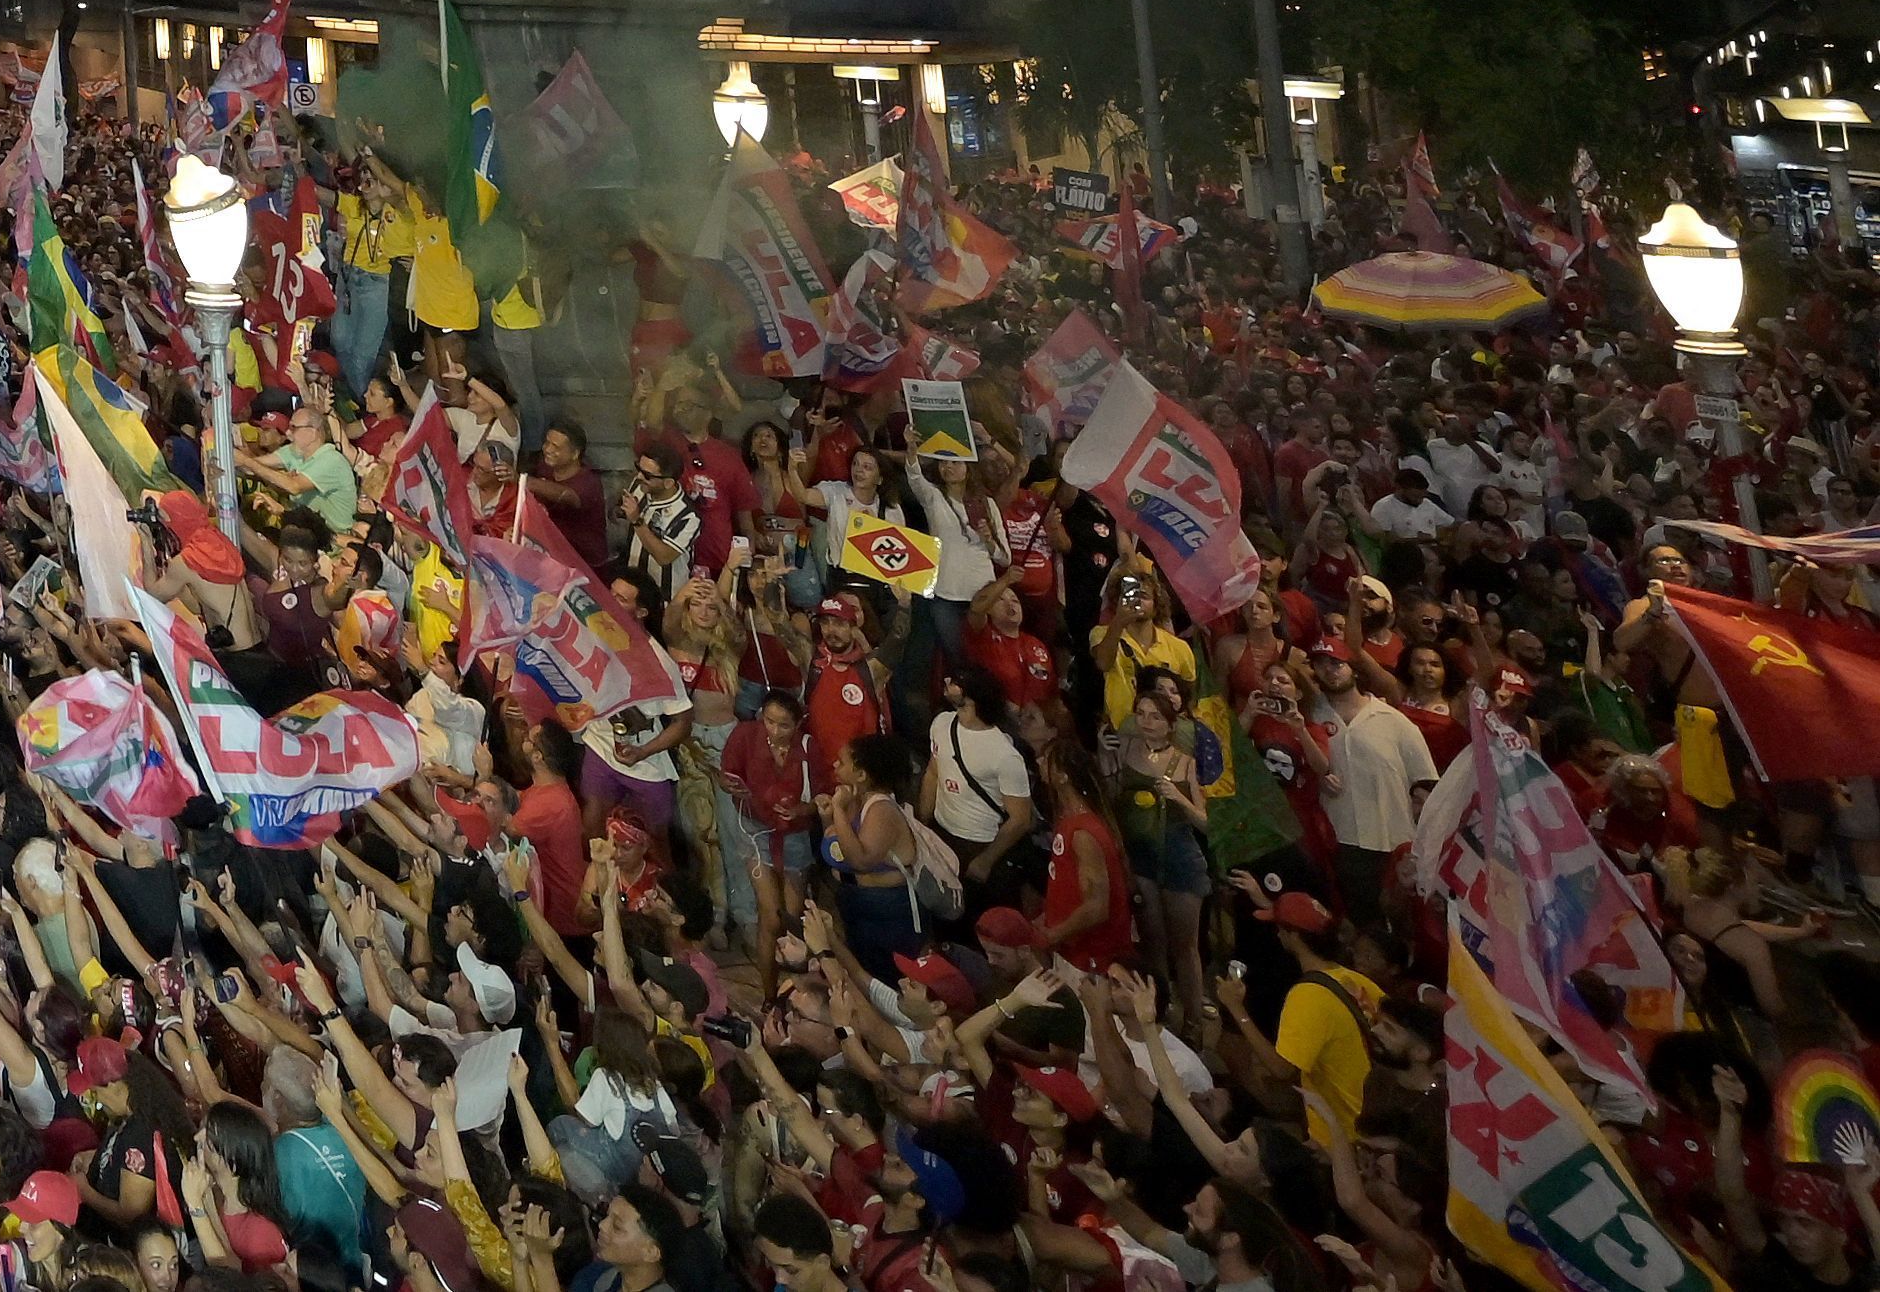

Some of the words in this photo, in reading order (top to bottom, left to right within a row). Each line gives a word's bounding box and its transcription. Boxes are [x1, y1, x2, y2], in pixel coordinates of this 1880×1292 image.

[847, 185, 899, 215] LU
[1068, 176, 1092, 189] COM
[753, 185, 824, 294] PRESIDENTE
[197, 712, 396, 777] LULA
[1549, 1161, 1687, 1292] 13
